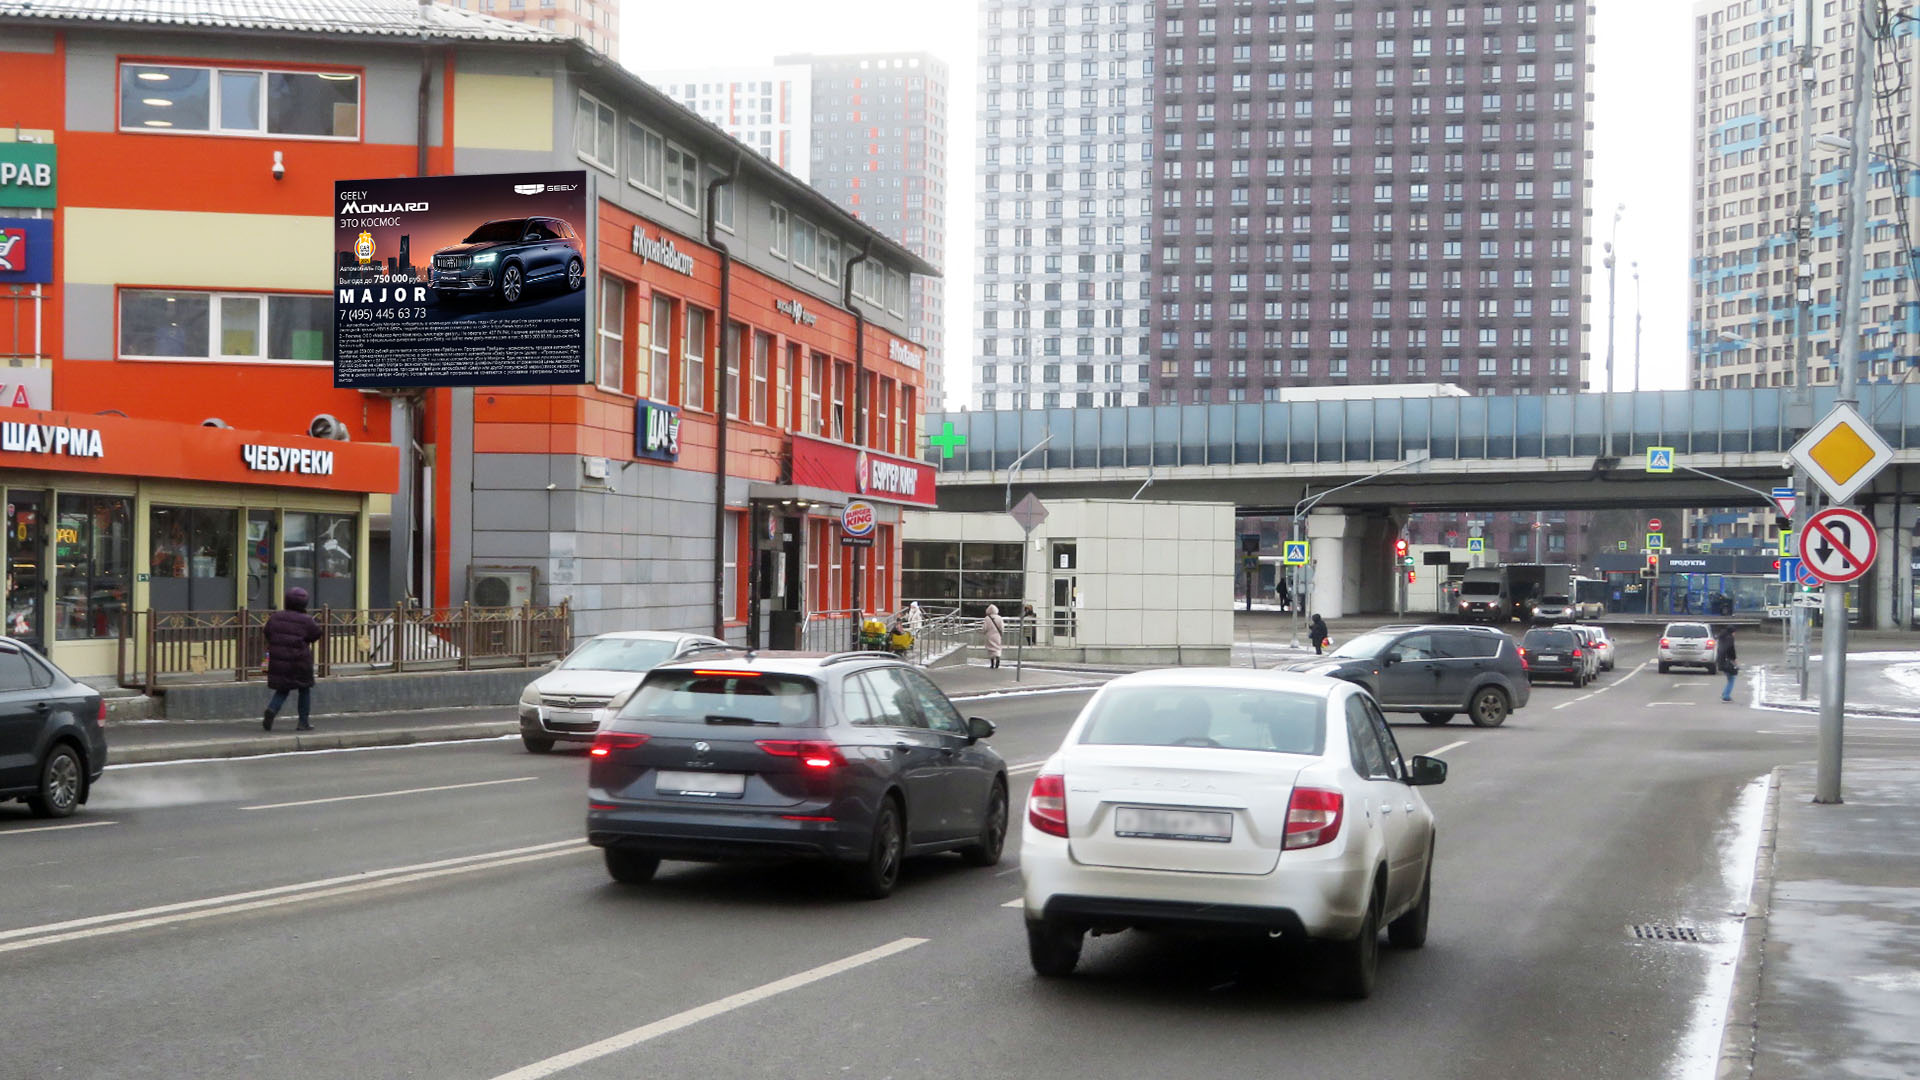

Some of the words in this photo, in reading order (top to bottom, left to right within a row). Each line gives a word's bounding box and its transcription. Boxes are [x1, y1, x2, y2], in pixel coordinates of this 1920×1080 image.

[547, 184, 578, 192] GEELY
[340, 191, 368, 200] GEELY
[340, 218, 358, 228] ЭТО
[361, 217, 401, 227] КОСМОС
[374, 275, 390, 283] 750
[391, 274, 408, 282] 000
[340, 287, 426, 303] MAJOR
[340, 310, 346, 320] 7
[348, 309, 373, 321] (495)
[375, 309, 395, 319] 445
[397, 308, 411, 319] 63
[413, 308, 427, 318] 73
[647, 408, 669, 450] ДА!
[2, 421, 104, 457] ШАУРМА
[244, 444, 333, 475] ЧЕБУРЕКИ
[872, 460, 899, 492] БУРГЕР
[900, 465, 918, 495] КИНГ
[845, 508, 872, 519] BURGER
[847, 513, 872, 528] KING
